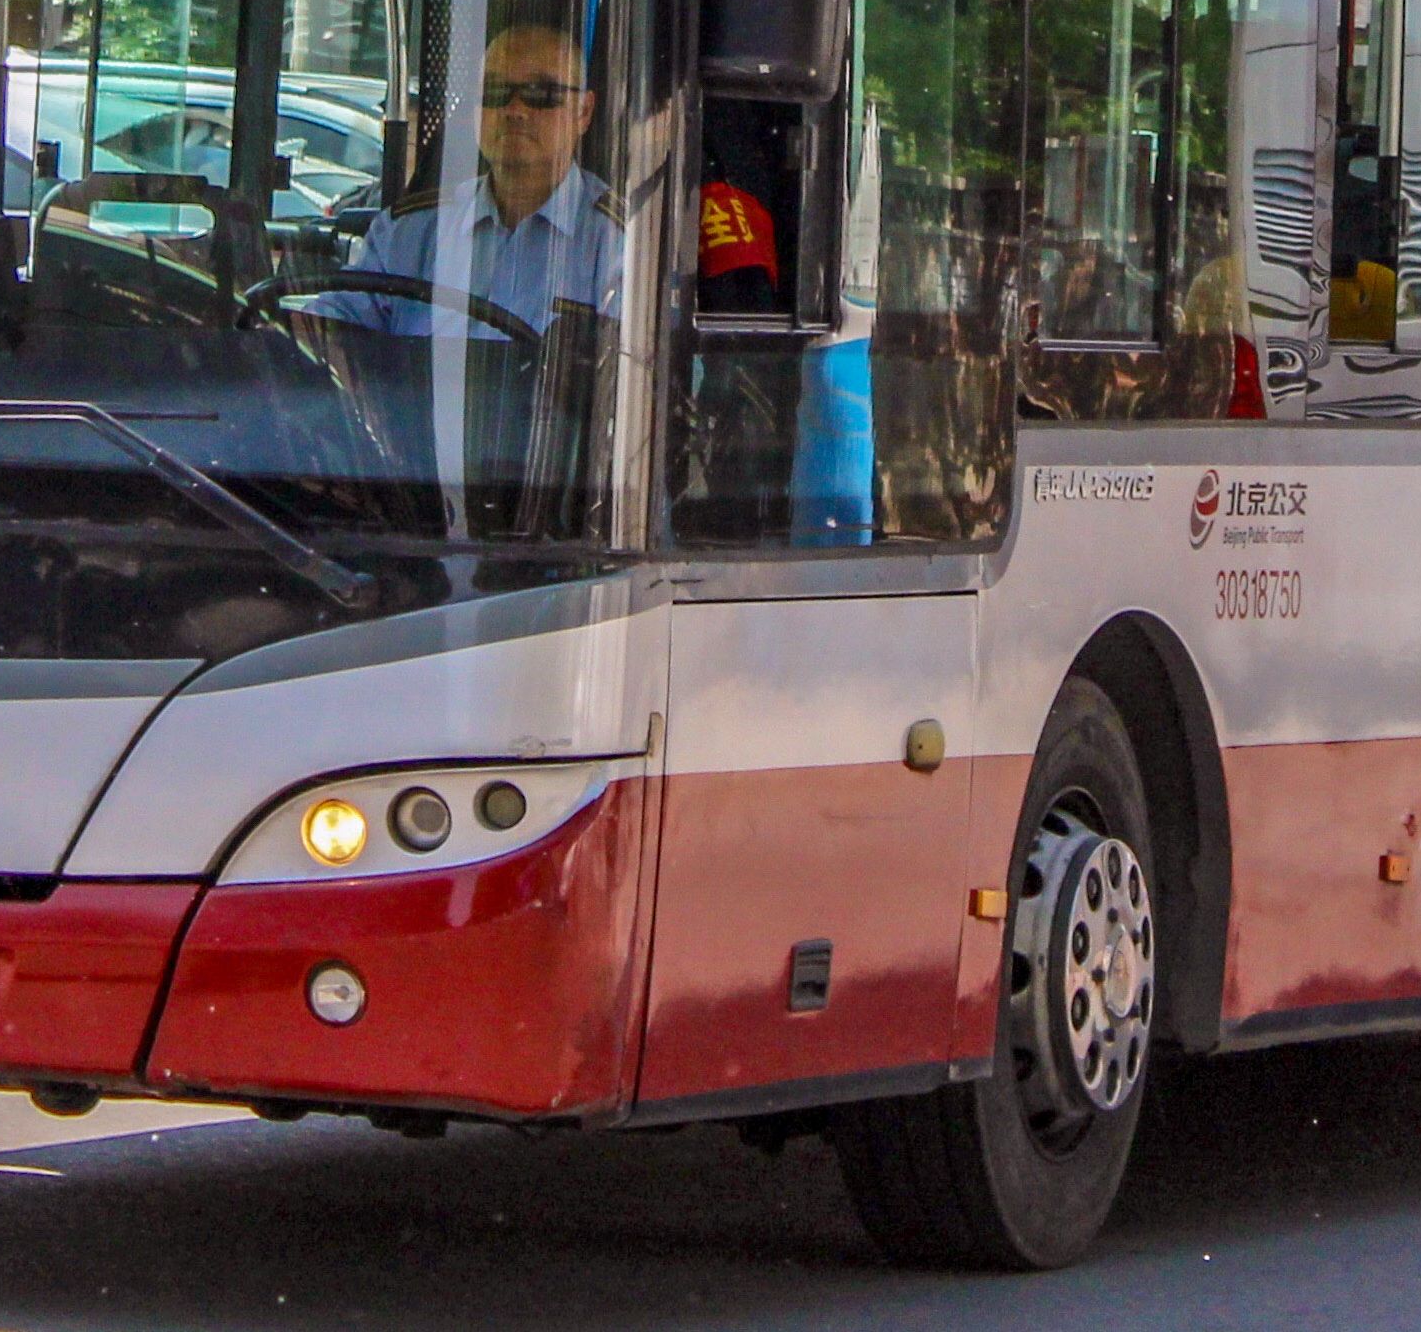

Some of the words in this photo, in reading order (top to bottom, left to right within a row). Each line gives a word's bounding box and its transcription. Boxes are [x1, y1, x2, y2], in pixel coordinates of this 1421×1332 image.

[1225, 481, 1309, 517] 北京公交
[1223, 525, 1247, 550] Beijing
[1248, 525, 1269, 546] Public
[1270, 525, 1305, 549] Transport
[1215, 570, 1302, 620] 30318750
